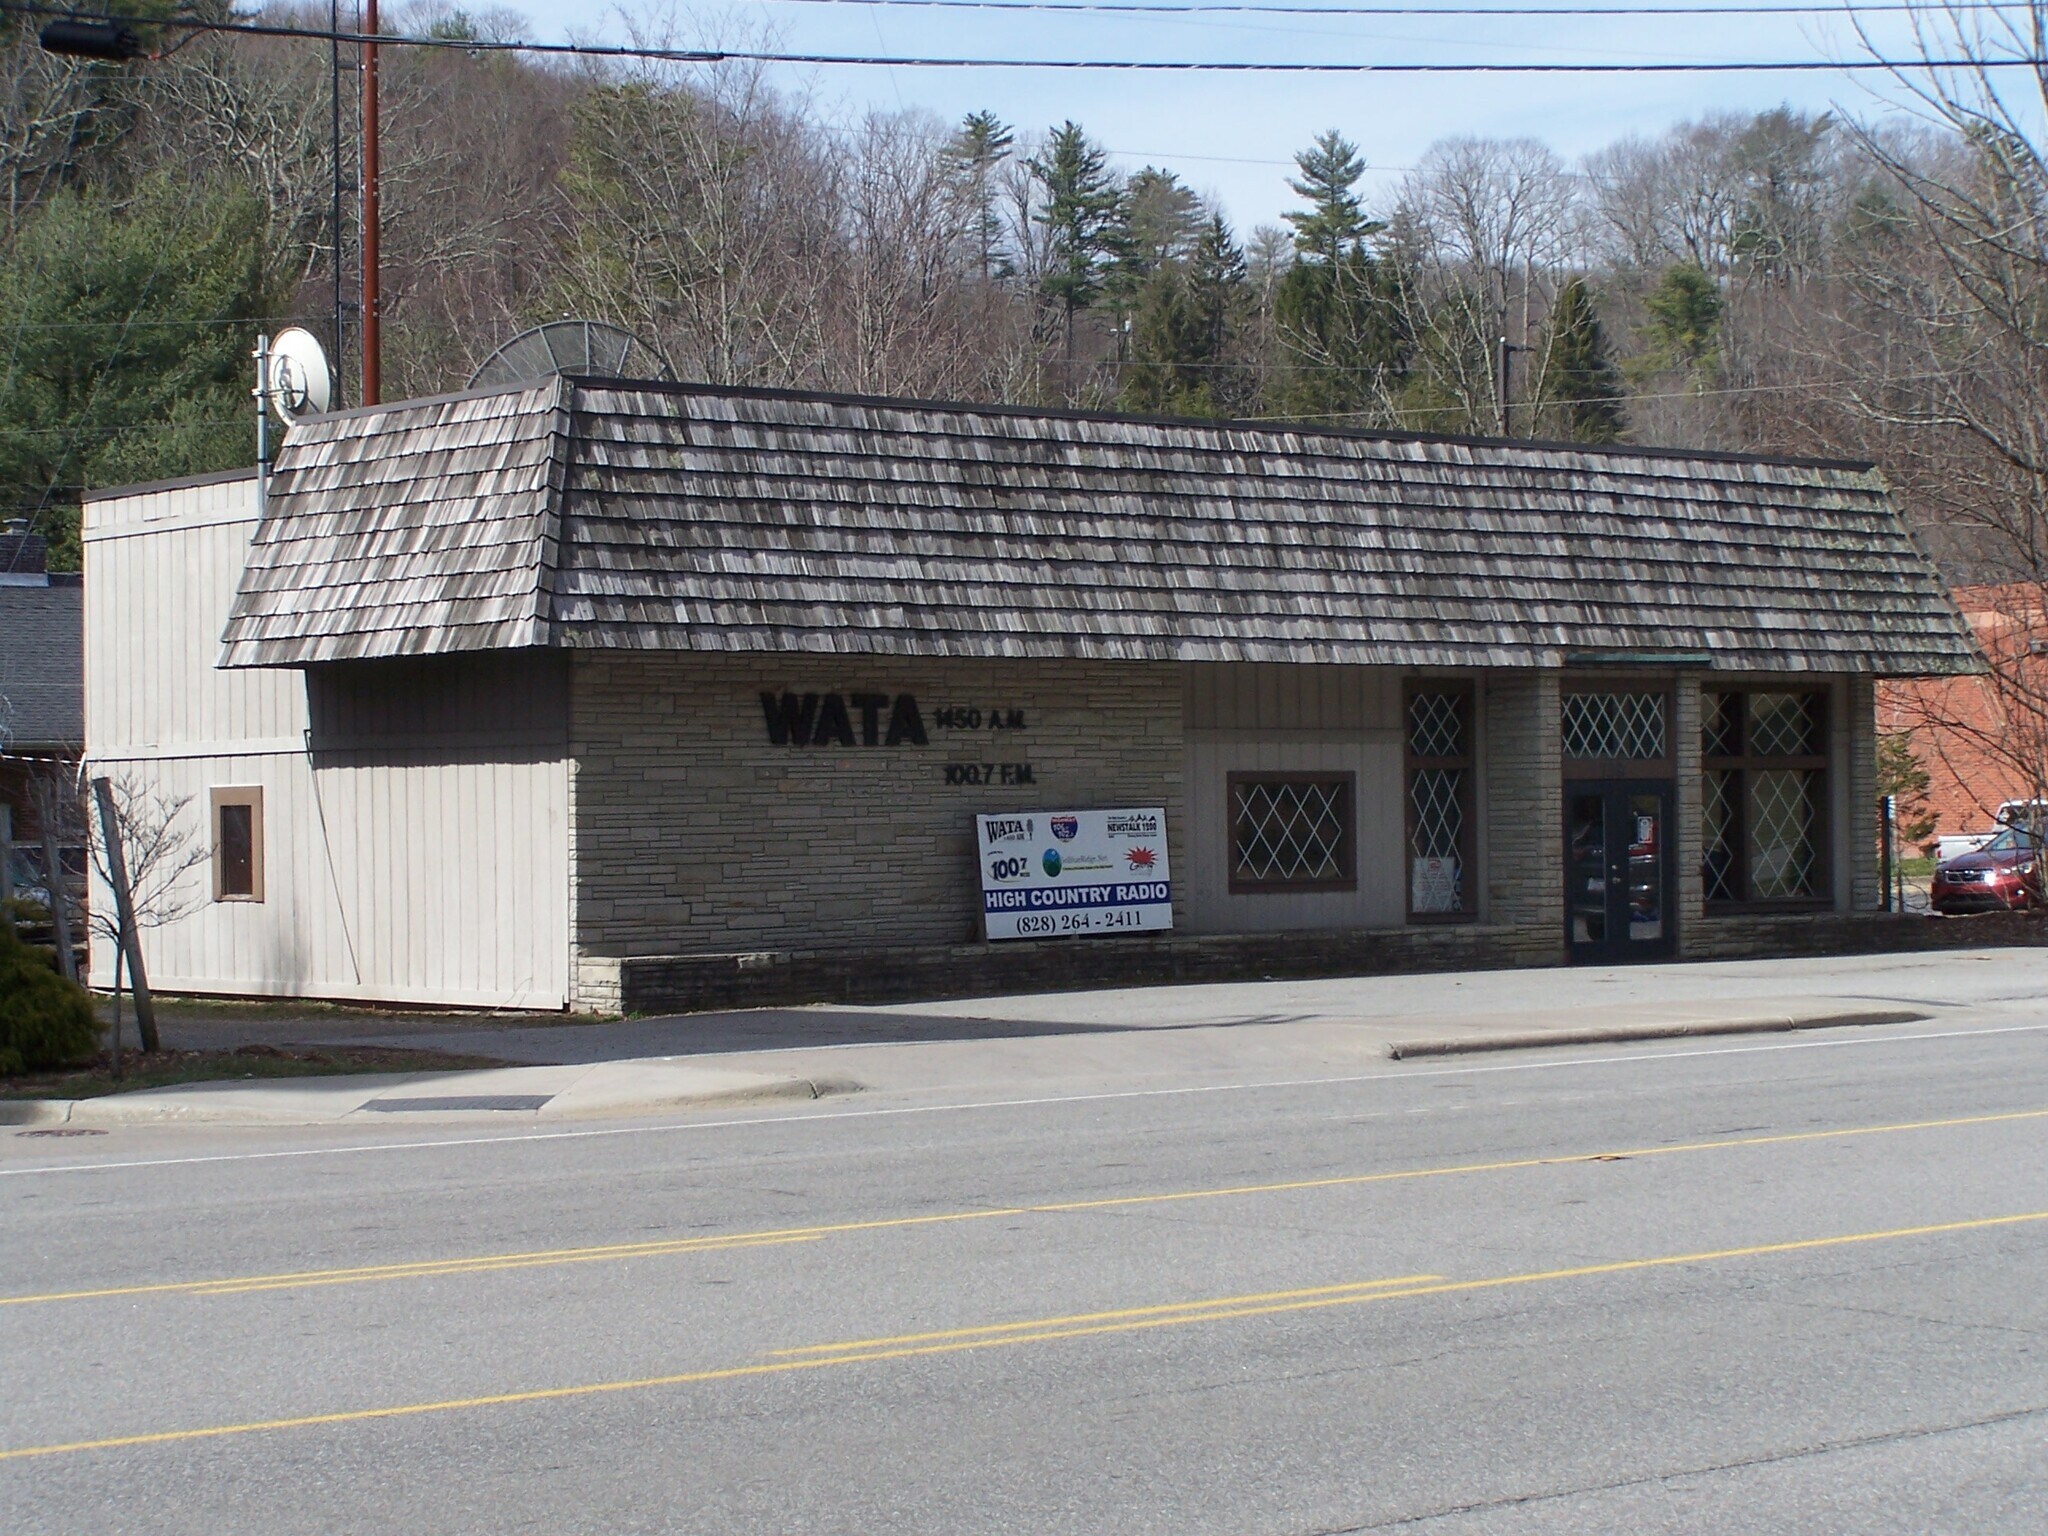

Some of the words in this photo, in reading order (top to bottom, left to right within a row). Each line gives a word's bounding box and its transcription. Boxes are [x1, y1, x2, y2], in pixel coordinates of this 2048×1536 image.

[759, 691, 929, 746] WATA
[933, 706, 982, 730] 1450
[943, 763, 995, 786] 100.7
[986, 820, 1024, 843] WATA
[1107, 822, 1141, 832] NEWSTALK
[986, 891, 1027, 908] HIGH
[1031, 886, 1112, 906] COUNTRY
[1116, 883, 1168, 901] RADIO
[1016, 915, 1056, 935] (828)
[1061, 913, 1090, 930] 264
[1105, 911, 1142, 927] 2411
